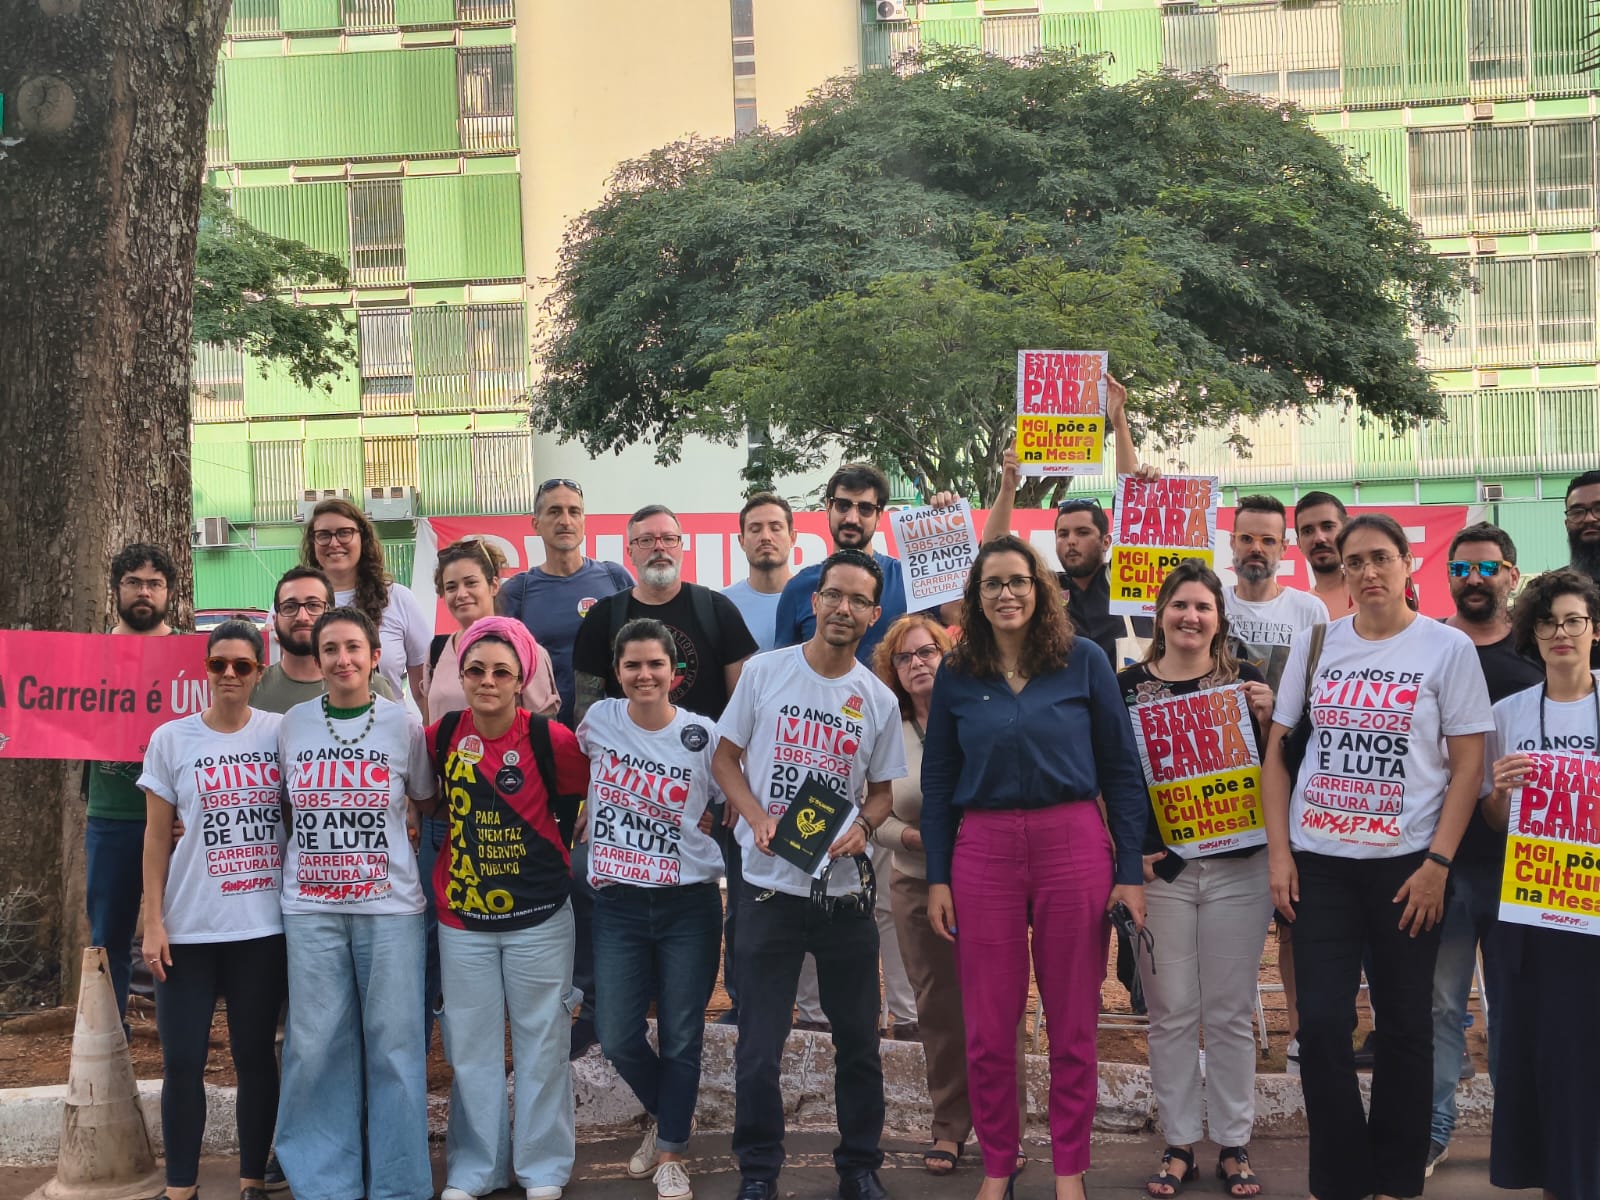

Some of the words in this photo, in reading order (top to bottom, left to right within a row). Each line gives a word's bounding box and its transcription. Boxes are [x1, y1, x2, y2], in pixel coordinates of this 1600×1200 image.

[1025, 353, 1102, 368] ESTAMOS
[1025, 365, 1101, 381] PARANDO
[1023, 380, 1100, 407] PARA
[1022, 419, 1052, 433] MGI,
[1056, 420, 1085, 434] põe
[1088, 423, 1097, 433] a
[1023, 432, 1095, 447] Cultura
[1024, 451, 1042, 460] na
[1046, 448, 1091, 460] Mesa!
[1125, 477, 1211, 495] ESTAMOS
[1123, 492, 1210, 509] PARANDO
[899, 514, 913, 523] 40
[915, 509, 945, 520] ANOS
[948, 504, 963, 514] DE
[1121, 507, 1208, 537] PARA
[901, 512, 966, 541] MINC
[905, 531, 969, 553] 1985-2025
[909, 554, 928, 567] 20
[932, 544, 972, 562] ANOS
[1118, 551, 1153, 567] MGI,
[911, 565, 930, 578] DE
[936, 556, 973, 573] LUTA
[913, 572, 960, 588] CARREIRA
[914, 582, 958, 597] CULTURA
[1121, 587, 1142, 598] na
[1345, 668, 1395, 683] ANOS
[1399, 672, 1424, 684] DE
[18, 675, 136, 713] Carreira
[146, 681, 162, 714] é
[1138, 689, 1238, 720] ESTAMOS
[1313, 680, 1419, 711] MINC
[779, 704, 800, 717] 40
[803, 708, 842, 729] ANOS
[845, 721, 863, 738] DE
[1142, 705, 1242, 738] PARANDO
[1313, 709, 1412, 732] 1985-2025
[775, 716, 861, 761] MINC
[1146, 723, 1249, 765] PARA
[1338, 732, 1409, 756] ANOS
[1541, 735, 1595, 750] ANOS
[194, 757, 214, 768] 40
[219, 752, 261, 765] ANOS
[264, 750, 280, 763] DE
[297, 750, 313, 762] 40
[316, 747, 365, 760] ANOS
[370, 750, 389, 765] DE
[292, 761, 390, 789] MINC
[621, 754, 666, 776] ANOS
[670, 767, 692, 781] DE
[1343, 754, 1406, 779] LUTA
[194, 763, 280, 793] MINC
[596, 753, 690, 810] MINC
[772, 764, 799, 782] 20
[806, 770, 848, 796] ANOS
[770, 782, 798, 801] DE
[1156, 785, 1198, 805] MGI,
[1202, 778, 1239, 799] põe
[1243, 776, 1255, 789] a
[1380, 783, 1402, 797] DA
[292, 793, 390, 808] 1985-2025
[1164, 793, 1257, 824] Cultura
[1304, 789, 1369, 811] CULTURA
[1375, 797, 1401, 813] JÁ!
[1519, 787, 1600, 831] PAR
[203, 812, 229, 829] 20
[322, 811, 386, 829] ANOS
[475, 810, 500, 825] PARA
[620, 812, 682, 841] ANOS
[1171, 827, 1194, 841] na
[1197, 809, 1257, 836] Mesa!
[204, 829, 232, 846] DE
[242, 825, 276, 842] LUT
[297, 831, 319, 850] DE
[330, 831, 389, 849] LUTA
[505, 827, 522, 841] FAZ
[594, 821, 616, 842] DE
[626, 831, 681, 856] LUTA
[299, 854, 365, 867] CARREIRA
[367, 854, 387, 866] DA
[478, 844, 484, 858] O
[487, 843, 526, 859] SERVIÇO
[1514, 842, 1559, 867] MGI,
[209, 859, 269, 875] CULTURA
[299, 869, 361, 881] CULTURA
[366, 864, 387, 879] JÁ!
[659, 858, 679, 873] DA
[1515, 887, 1542, 903] na
